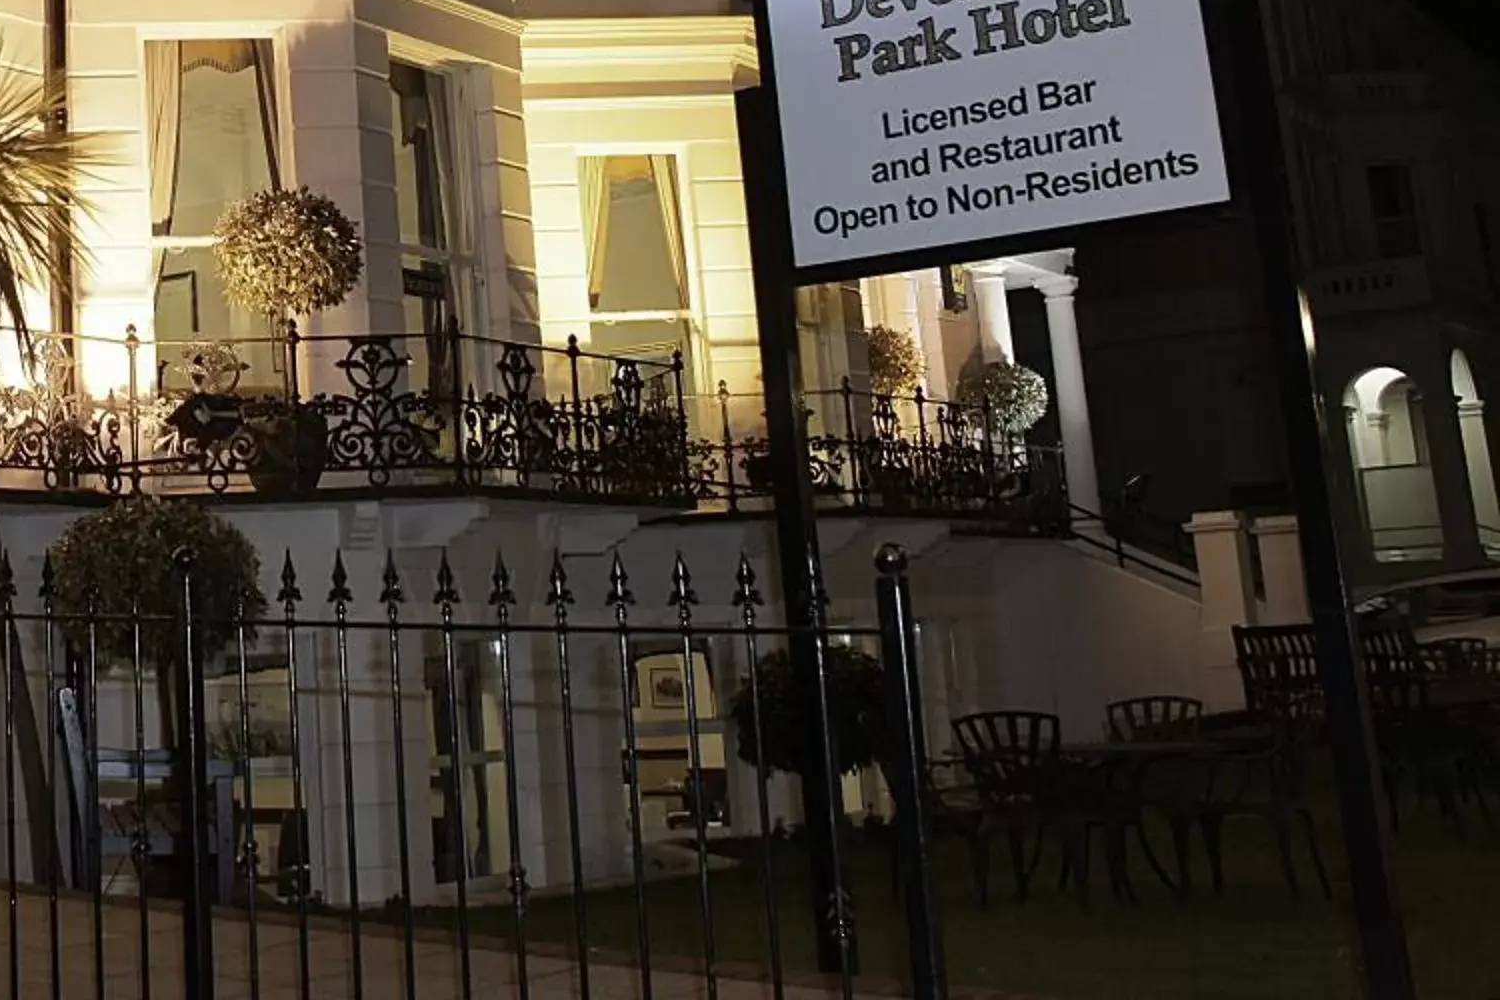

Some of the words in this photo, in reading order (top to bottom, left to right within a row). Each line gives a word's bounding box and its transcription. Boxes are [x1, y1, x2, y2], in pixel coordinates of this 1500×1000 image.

[834, 16, 962, 83] Park
[881, 87, 1029, 140] Licensed
[1037, 76, 1098, 112] Bar
[870, 148, 932, 184] and
[940, 115, 1123, 173] Restaurant
[813, 201, 900, 240] Open
[906, 194, 939, 222] to
[946, 149, 1201, 216] Non-Residents
